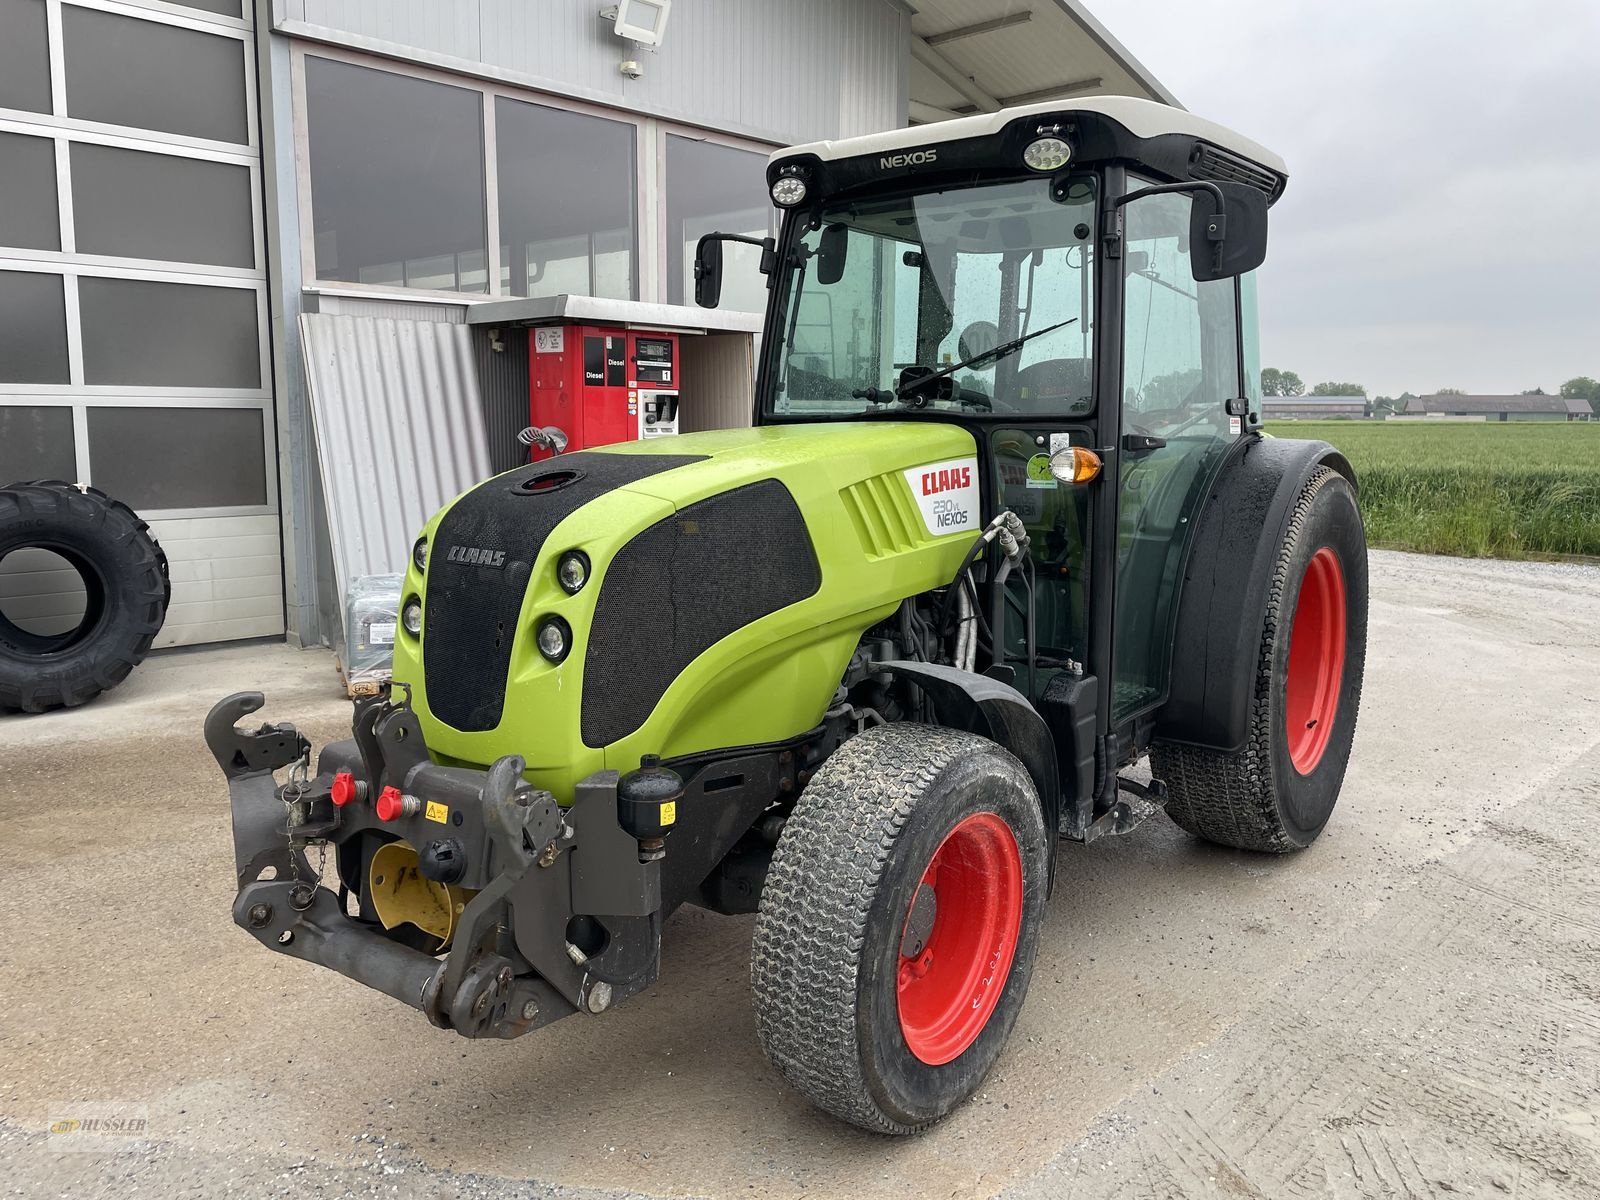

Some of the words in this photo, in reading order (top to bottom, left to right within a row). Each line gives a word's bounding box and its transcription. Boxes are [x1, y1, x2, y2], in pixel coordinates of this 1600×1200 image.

[880, 149, 937, 170] NEXOS
[586, 371, 604, 379] Diesel
[922, 467, 971, 496] CLAAS
[933, 500, 953, 514] 230
[937, 510, 968, 527] NEXOS
[447, 546, 506, 566] CLAAS
